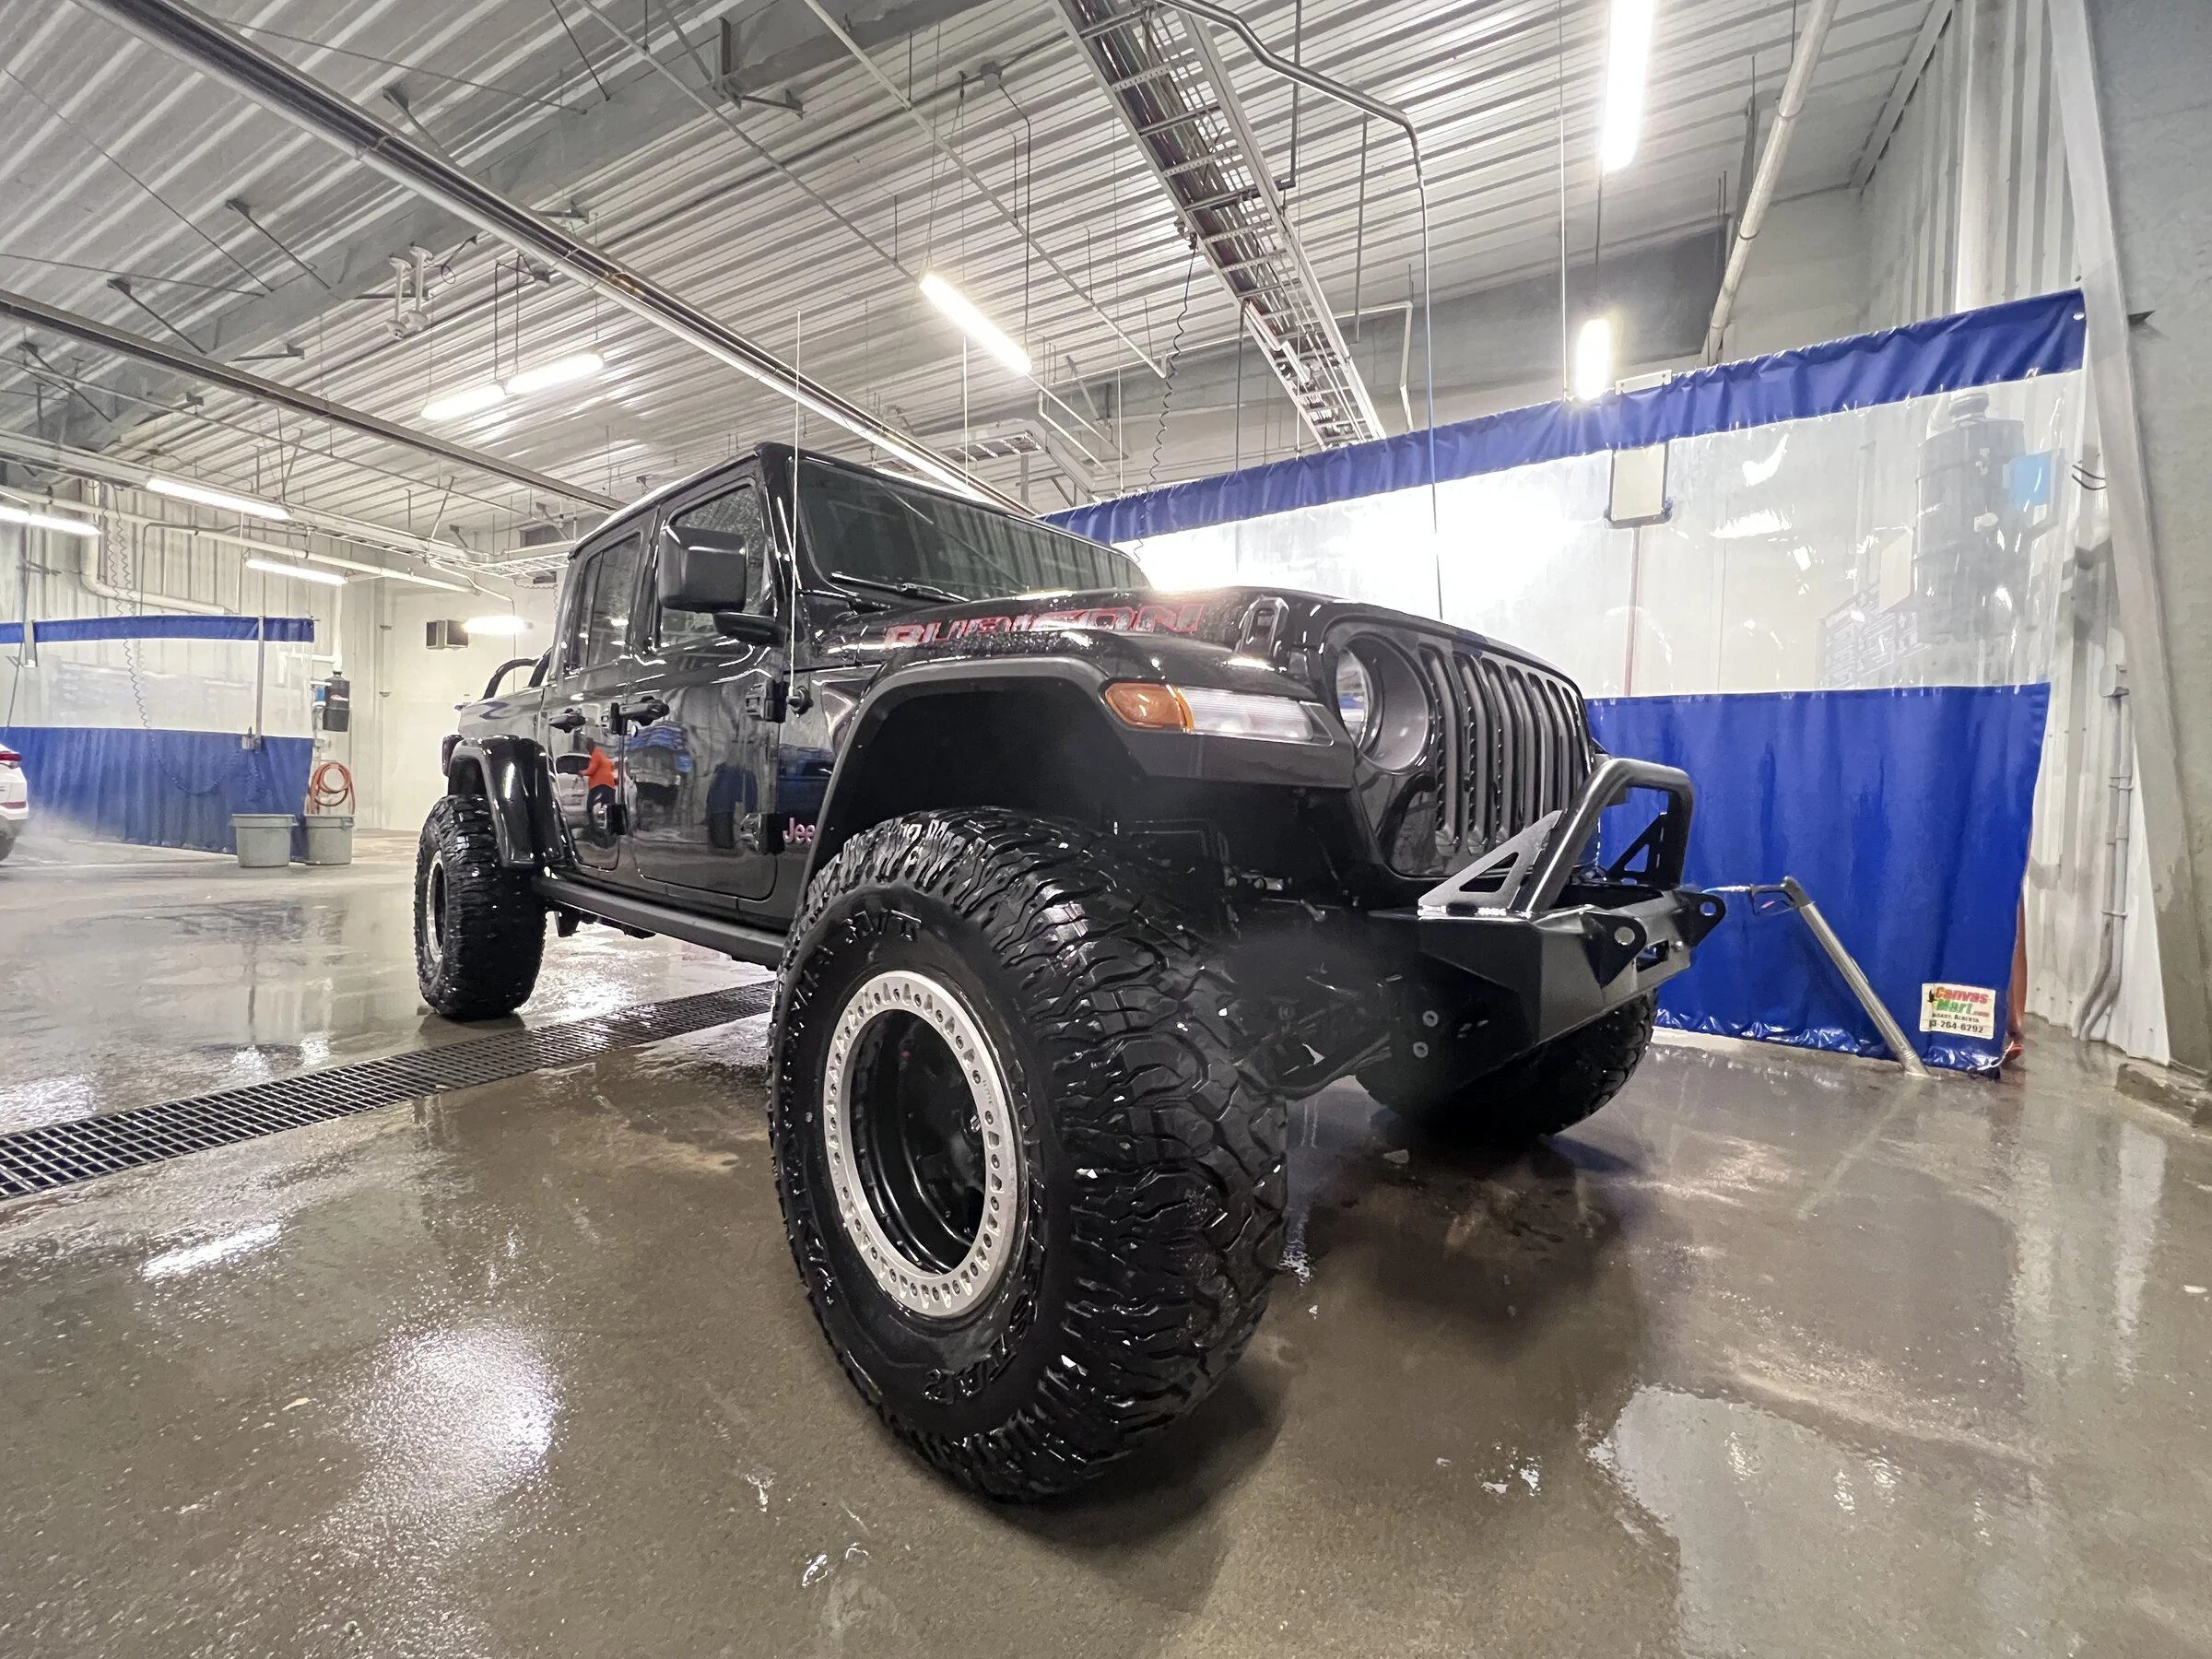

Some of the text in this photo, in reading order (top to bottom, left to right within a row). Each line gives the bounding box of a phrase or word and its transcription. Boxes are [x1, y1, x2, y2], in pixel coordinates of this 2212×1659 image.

[883, 604, 1206, 649] RUBICON
[782, 818, 816, 844] Jee
[1936, 986, 1989, 1004] Canvas
